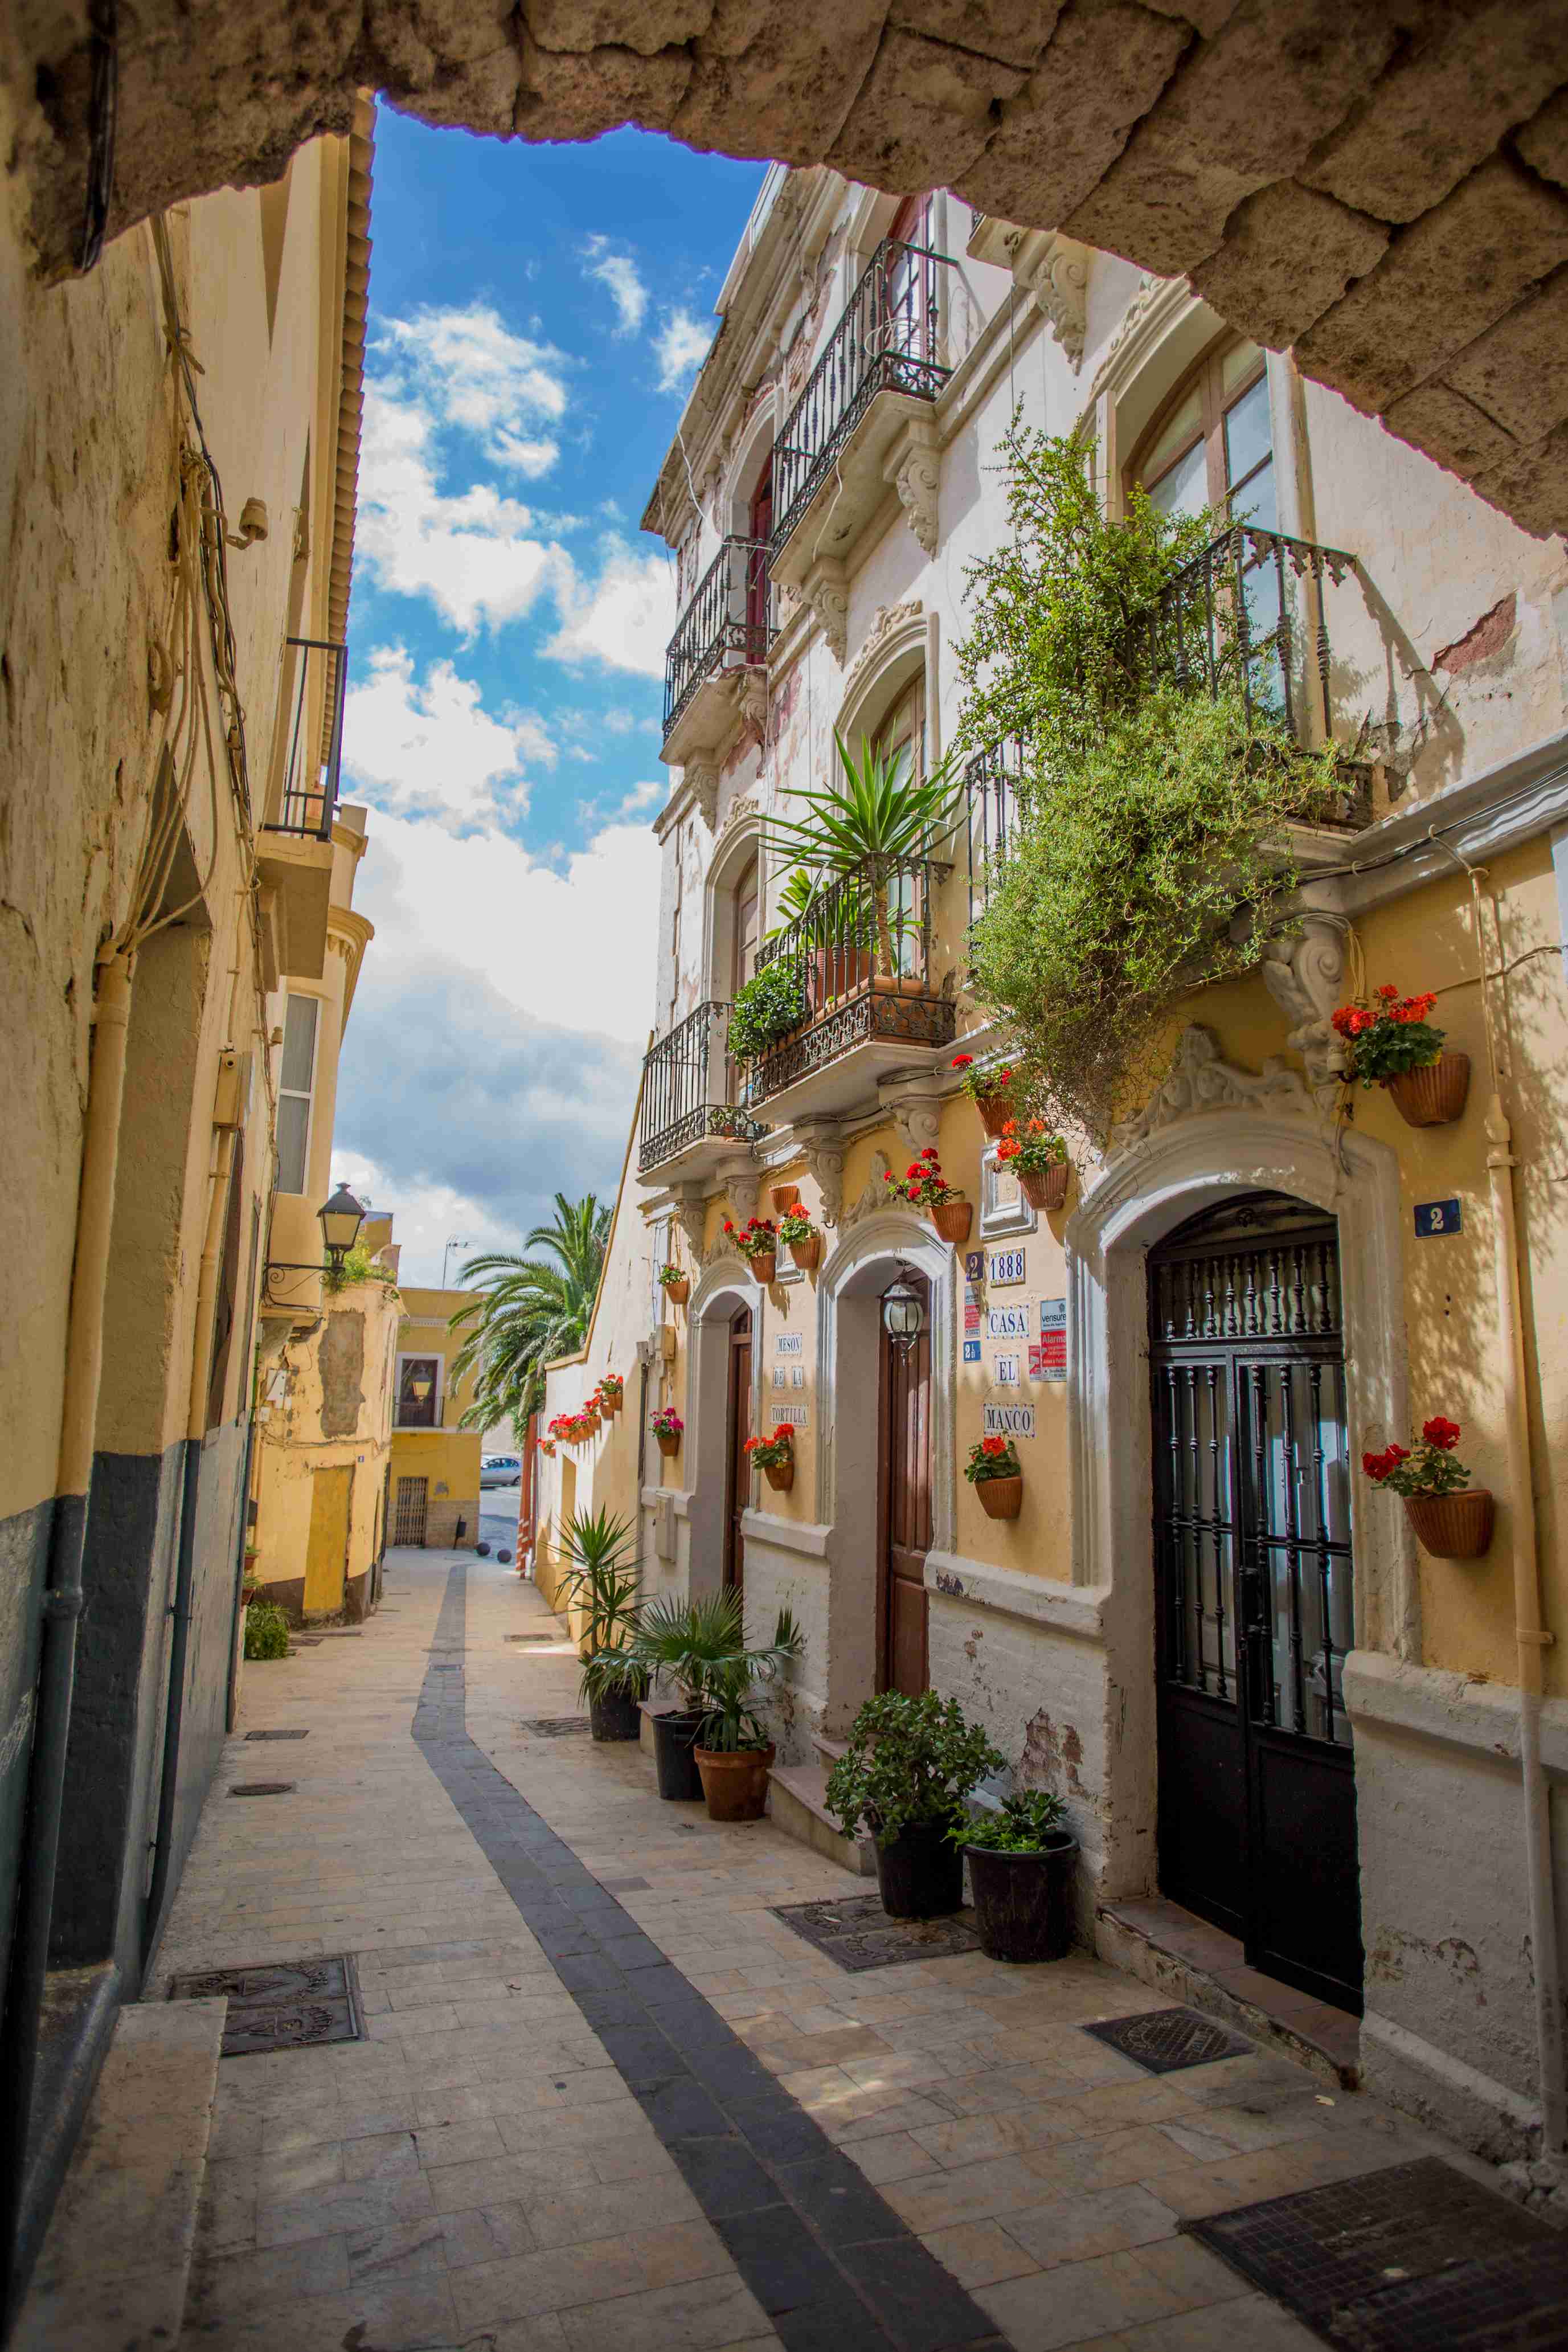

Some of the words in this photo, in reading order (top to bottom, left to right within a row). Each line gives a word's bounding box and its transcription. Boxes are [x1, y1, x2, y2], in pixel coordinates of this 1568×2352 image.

[1430, 1207, 1444, 1230] 2
[970, 1255, 978, 1279] 2
[990, 1253, 1022, 1280] 1888
[990, 1311, 1026, 1333] CASA
[778, 1336, 802, 1352] MESON
[774, 1371, 784, 1385] DE
[793, 1370, 803, 1385] LA
[999, 1361, 1015, 1381] EL
[772, 1407, 807, 1424] TORTILLA
[986, 1409, 1031, 1431] MANCO
